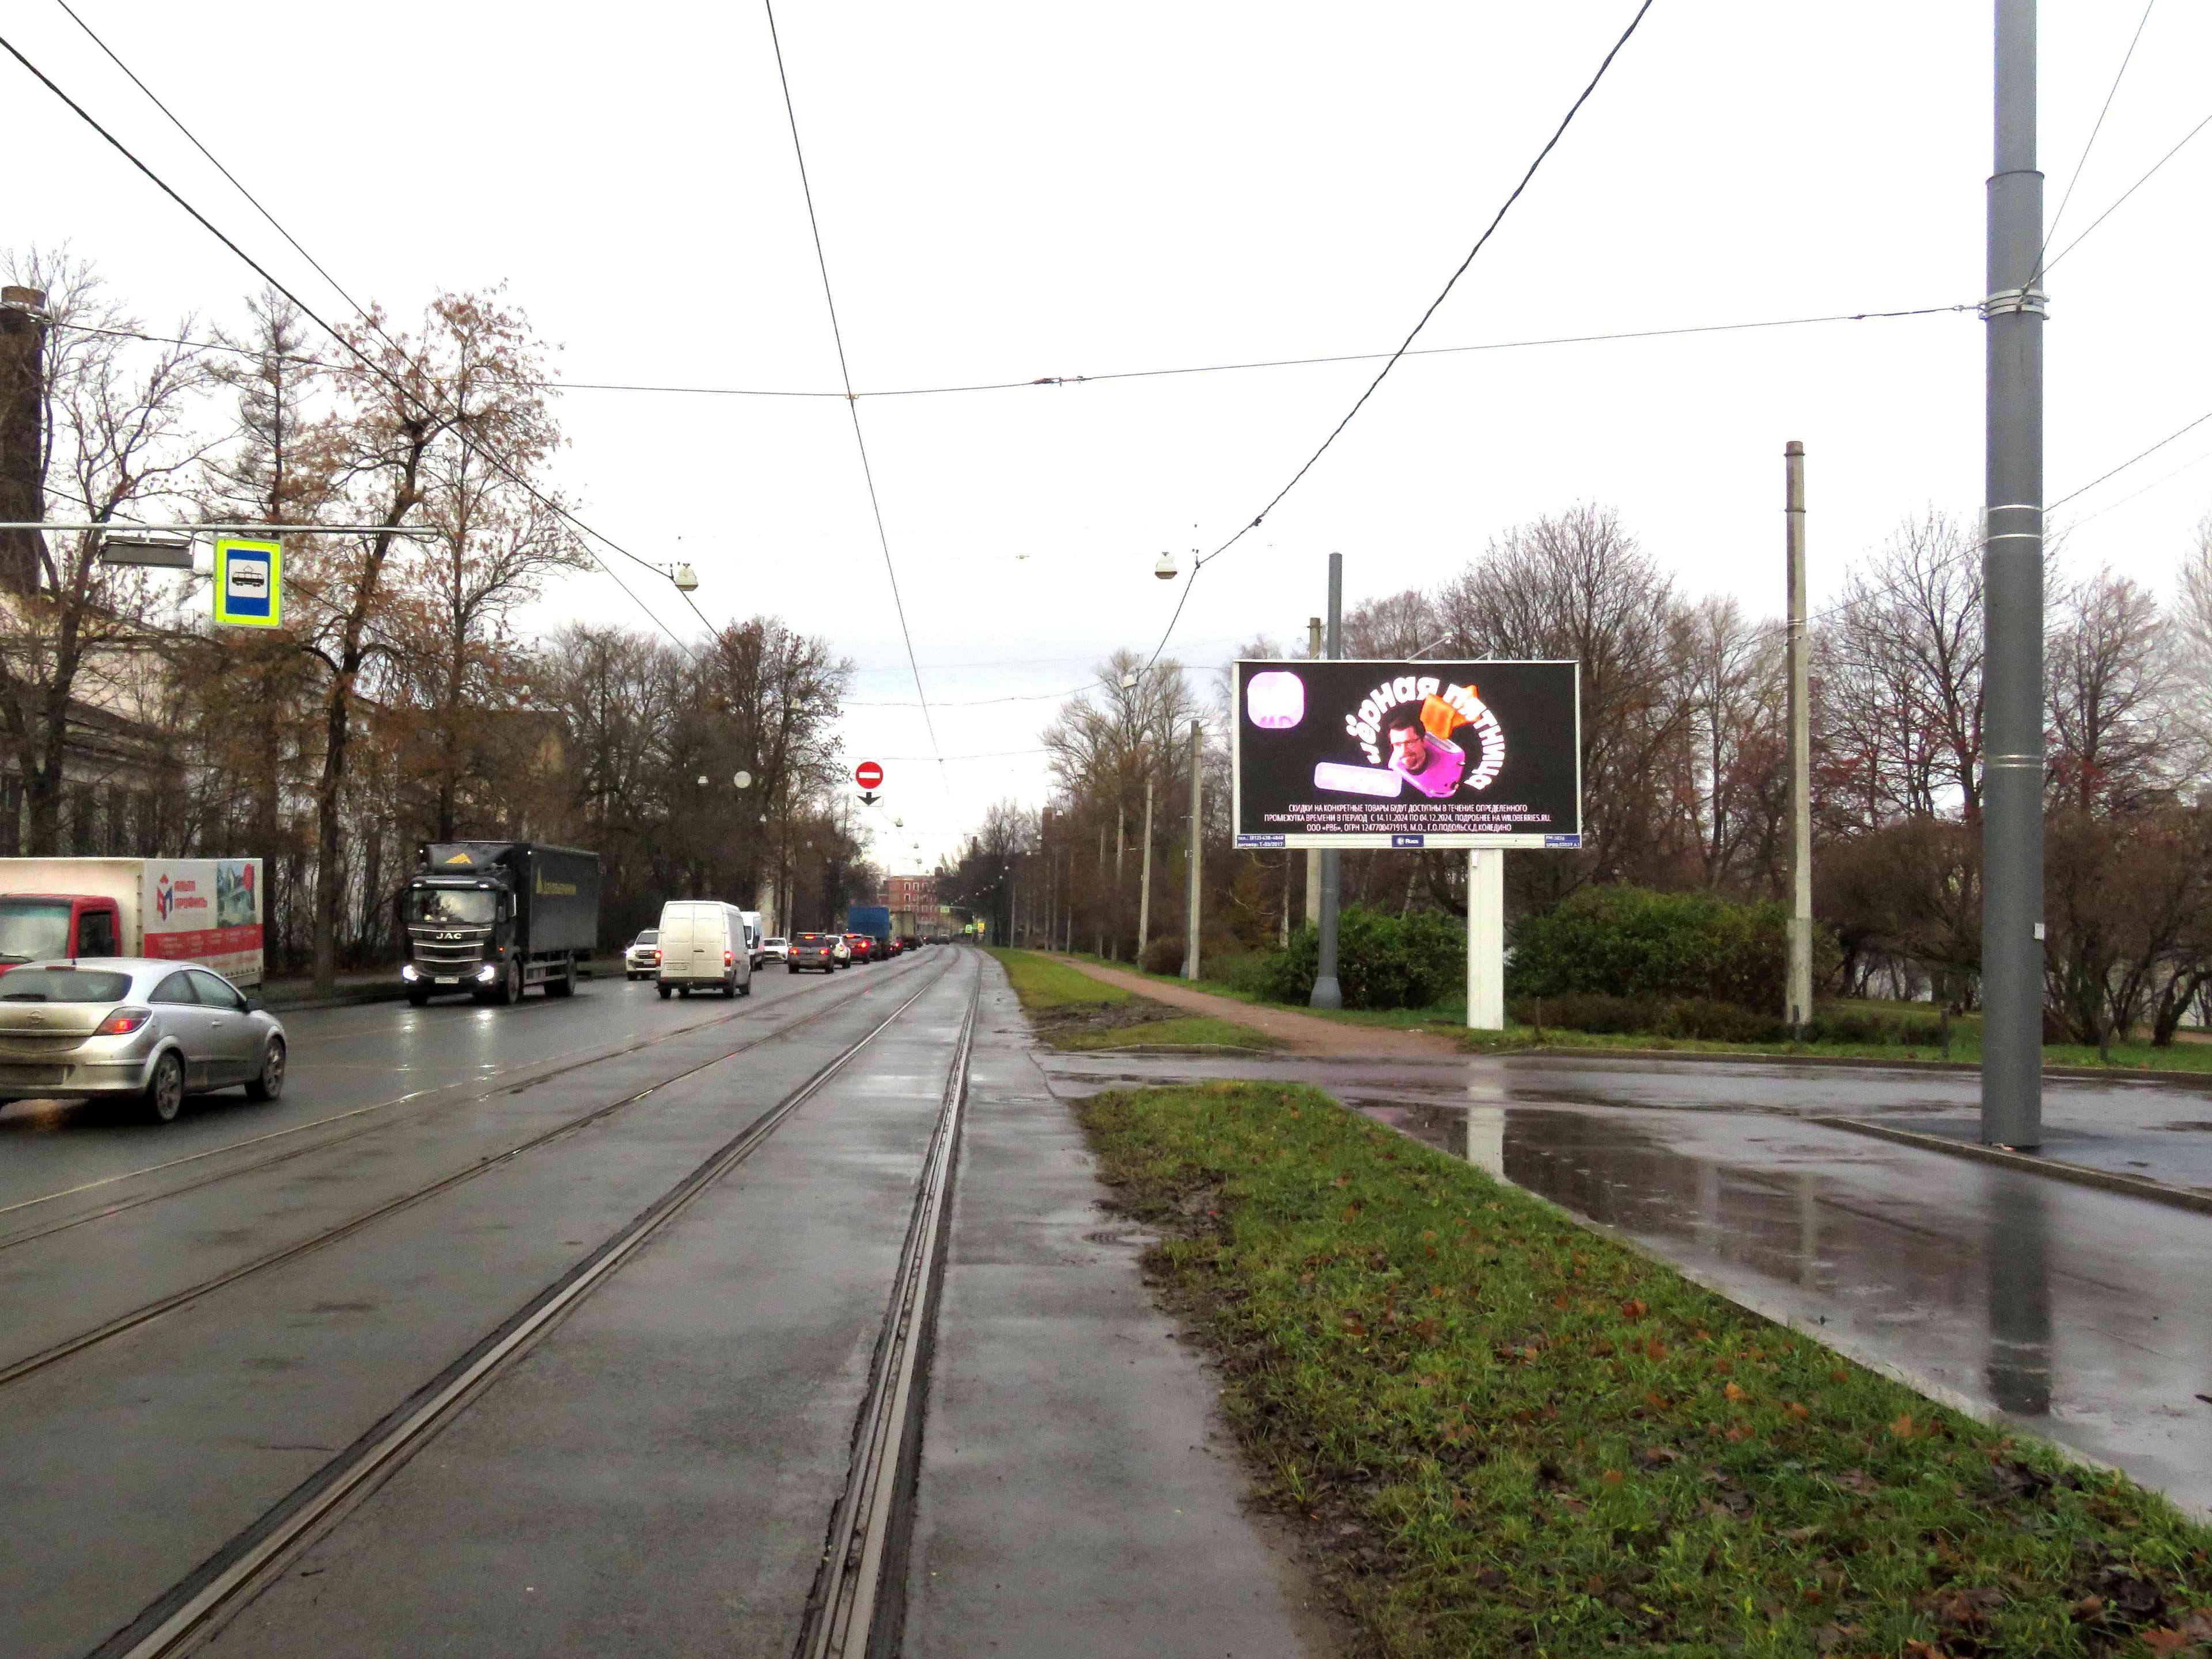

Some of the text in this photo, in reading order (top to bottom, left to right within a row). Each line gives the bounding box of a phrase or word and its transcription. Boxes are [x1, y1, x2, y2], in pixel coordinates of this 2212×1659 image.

[1289, 804, 1313, 813] СКИДКИ
[1390, 804, 1407, 813] БУДУТ
[1408, 804, 1441, 813] ДОСТУПНЫ
[1476, 804, 1528, 813] ОПРЕДЕЛЕННОГО
[1342, 814, 1368, 823] ПЕРИОД
[1455, 814, 1491, 823] ПОДРОБНЕЕ
